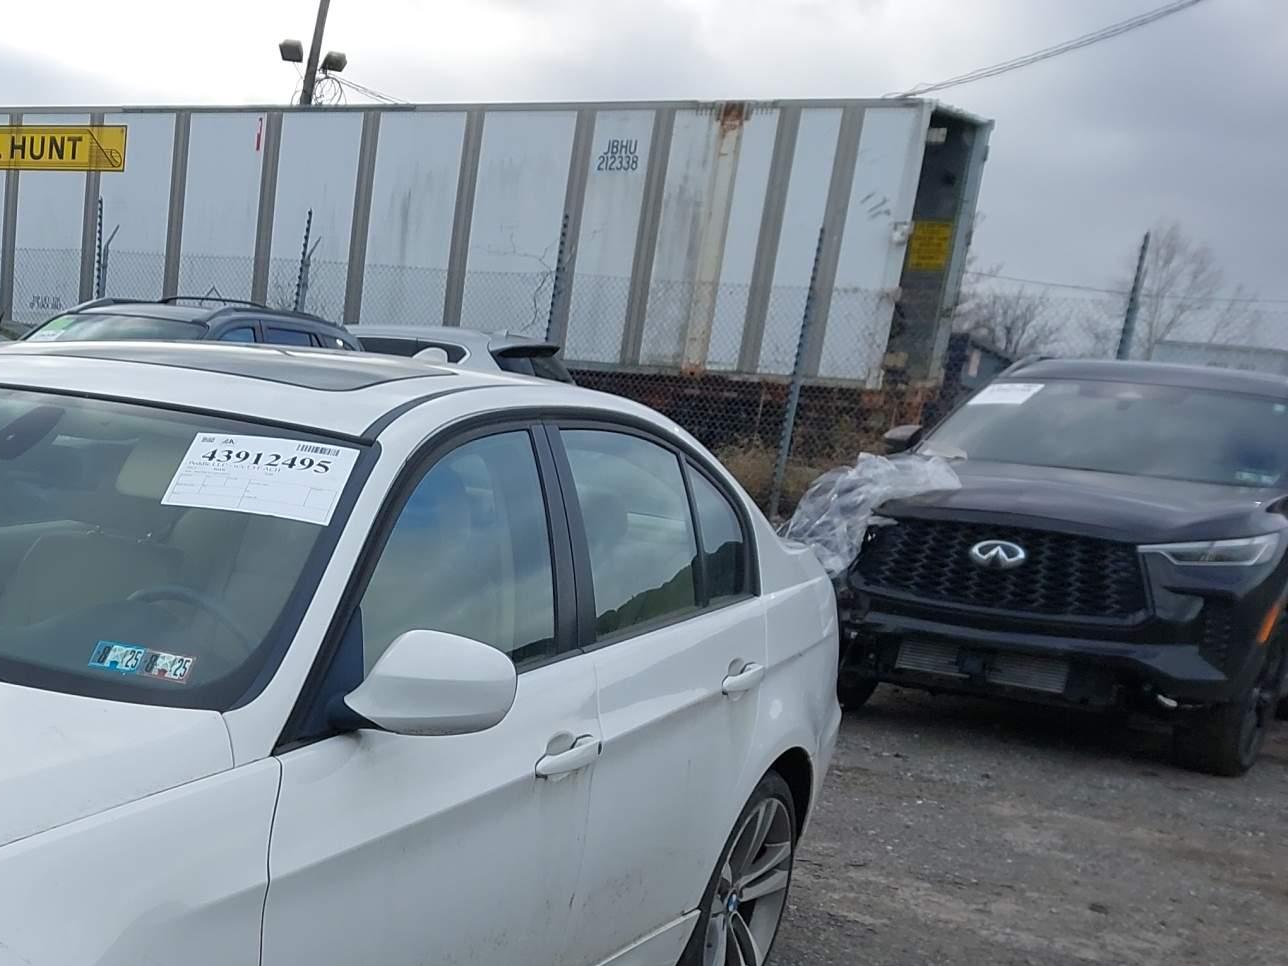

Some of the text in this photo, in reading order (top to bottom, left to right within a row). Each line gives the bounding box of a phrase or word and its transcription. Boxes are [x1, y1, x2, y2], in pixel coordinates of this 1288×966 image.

[10, 135, 83, 161] HUNT
[603, 139, 638, 155] JBHU
[596, 154, 639, 171] 212338
[201, 448, 333, 474] 43912495
[125, 650, 142, 668] 25
[173, 659, 191, 678] 25
